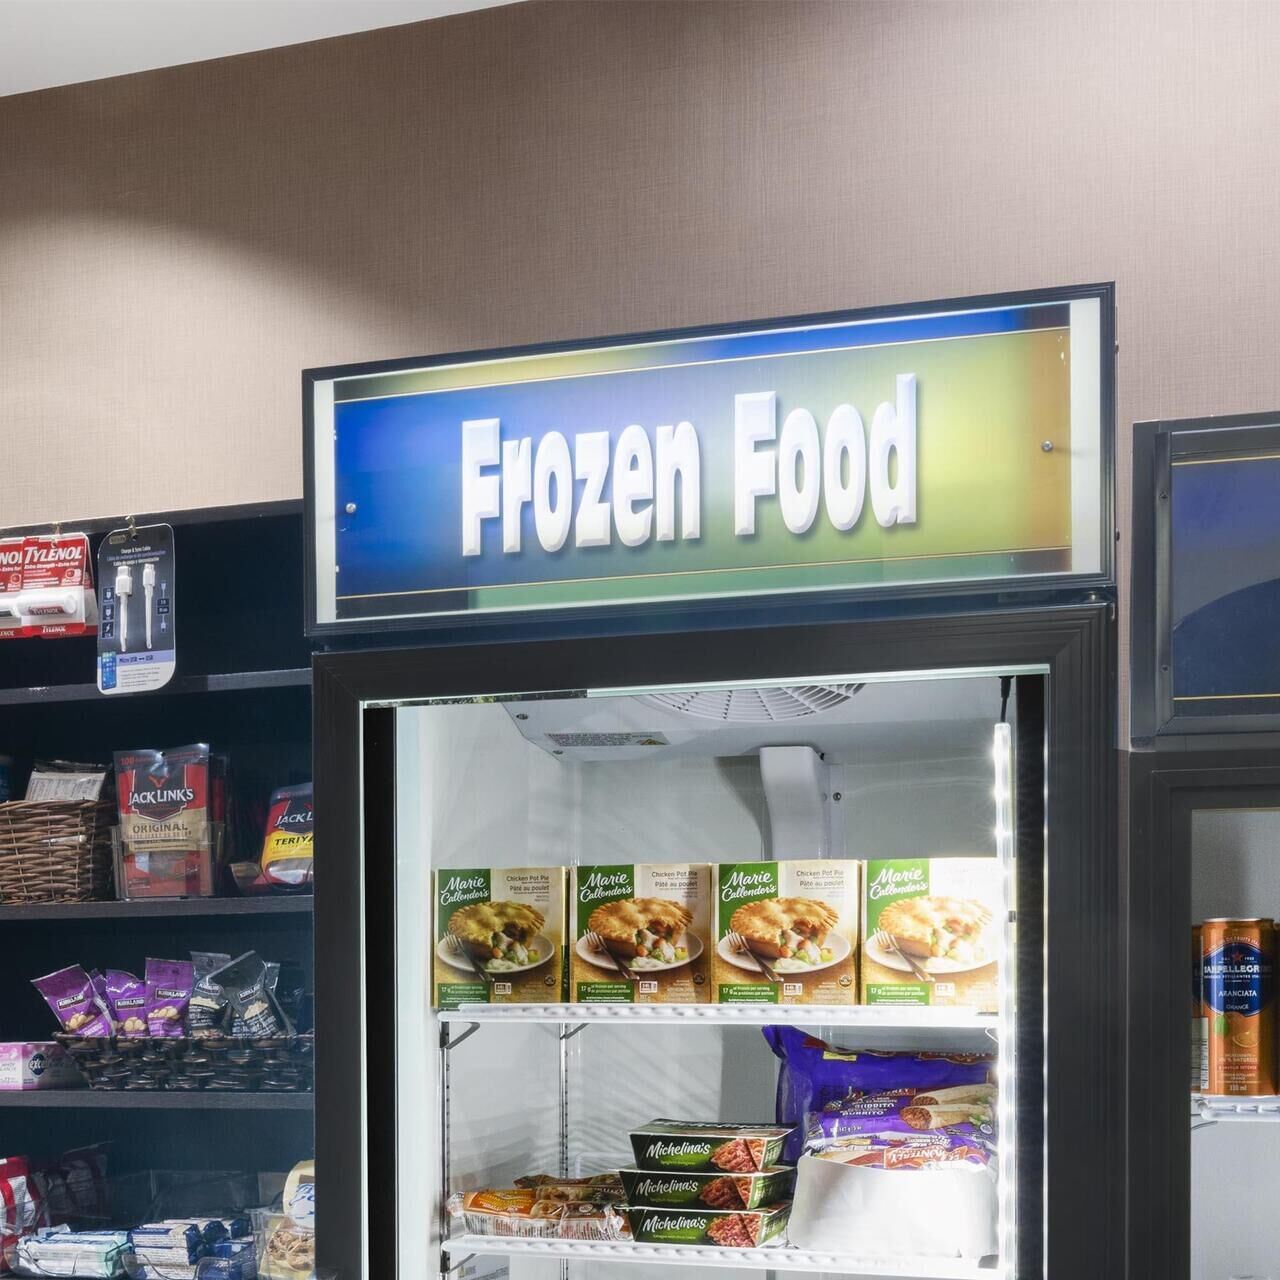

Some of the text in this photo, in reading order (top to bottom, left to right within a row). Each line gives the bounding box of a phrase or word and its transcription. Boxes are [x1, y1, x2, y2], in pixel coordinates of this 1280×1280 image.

[462, 373, 917, 557] Frozen Food
[24, 546, 83, 564] TYLENOL
[41, 625, 66, 634] TYLENOL
[128, 787, 195, 806] JACK LINK'S
[132, 822, 189, 834] ORIGINAL
[275, 813, 305, 827] JACK
[506, 874, 550, 882] Chicken Pot Pie
[580, 871, 630, 891] Marie
[651, 870, 673, 878] Chicken
[721, 870, 774, 890] Marie
[796, 869, 821, 877] Chicken
[871, 867, 925, 888] Marie
[440, 875, 486, 894] Marie
[509, 883, 524, 892] Pâté
[654, 879, 669, 888] Pâté
[870, 881, 930, 900] Callender's
[440, 888, 490, 906] Callender's
[580, 884, 633, 903] Callender's
[721, 884, 777, 902] Callender's
[645, 1141, 711, 1159] Michelina's
[636, 1178, 699, 1197] Michelina's
[642, 1215, 707, 1232] Michelina's
